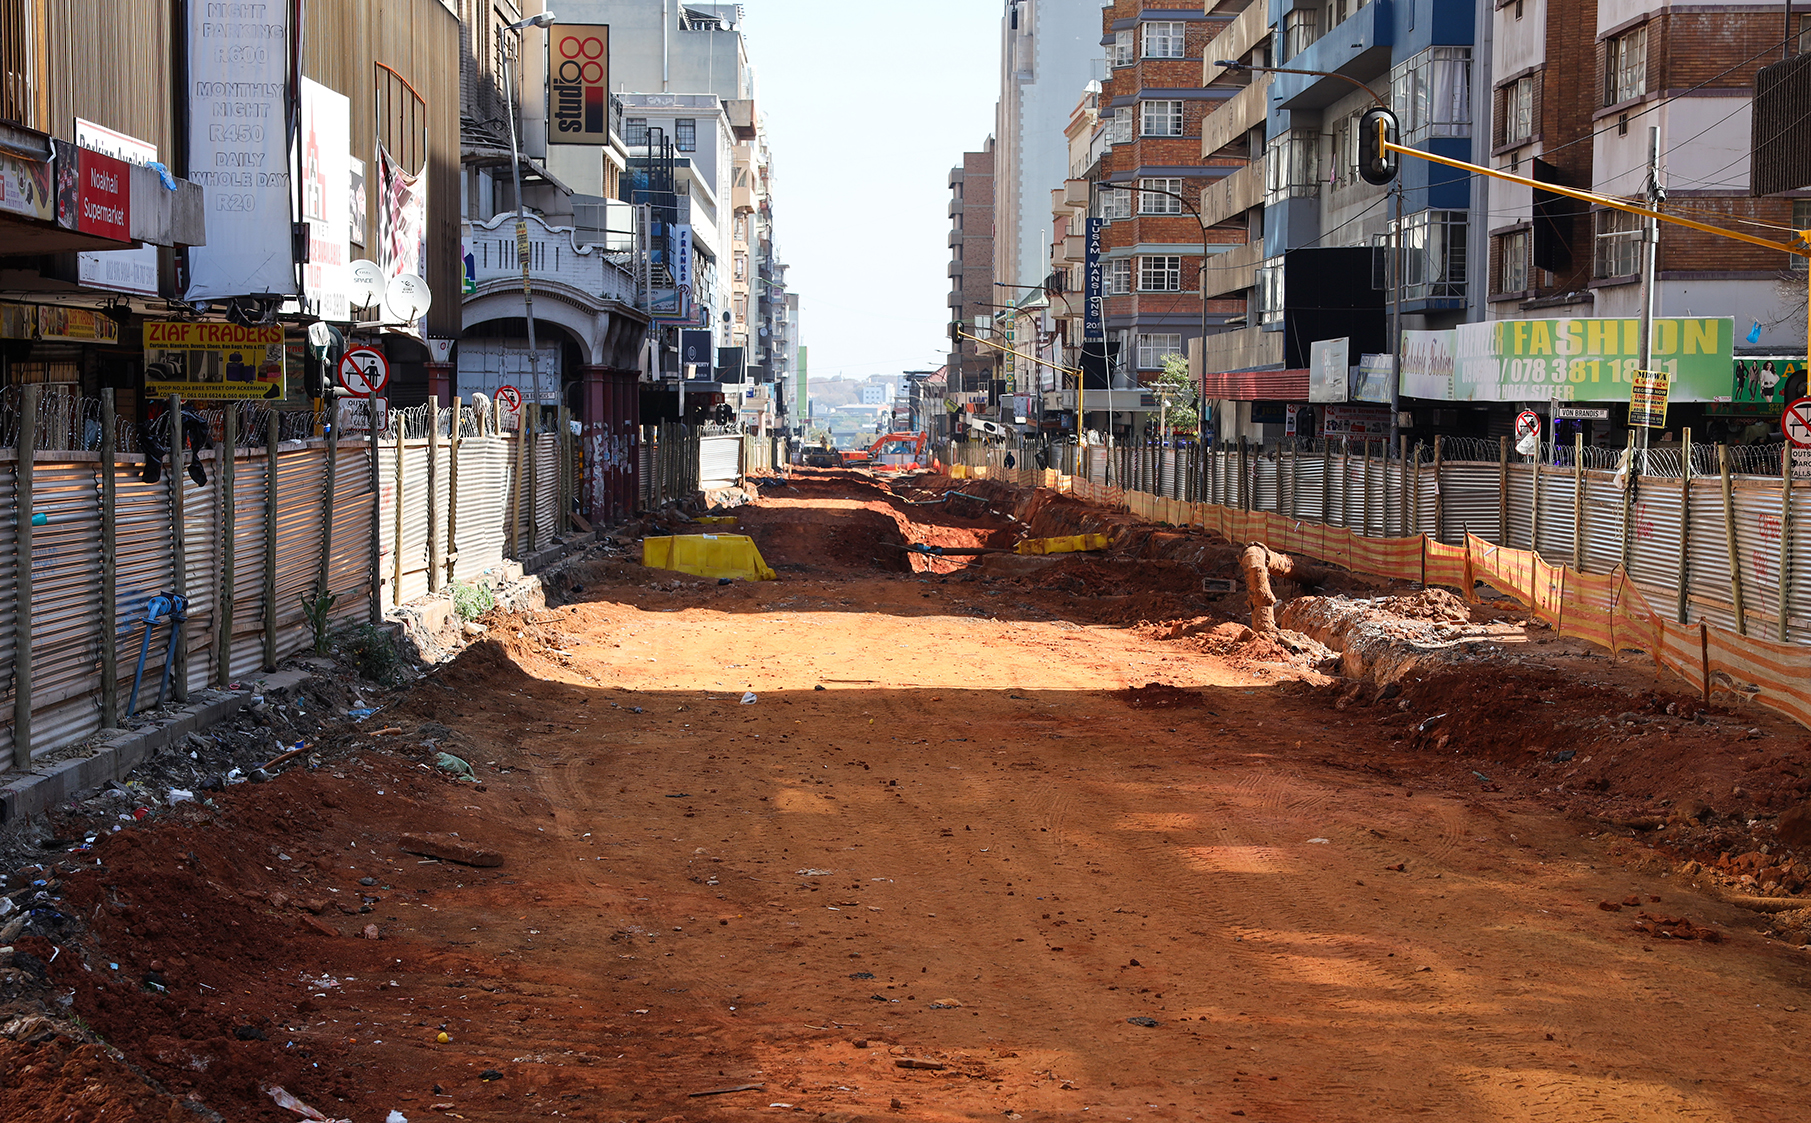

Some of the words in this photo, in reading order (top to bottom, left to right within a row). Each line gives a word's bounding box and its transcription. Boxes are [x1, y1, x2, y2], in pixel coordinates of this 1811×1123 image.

[208, 3, 266, 19] NIGHT
[203, 22, 284, 39] PARKING
[214, 45, 269, 64] R600
[196, 81, 285, 98] MONTHLY
[213, 102, 271, 118] NIGHT
[209, 124, 264, 142] R450
[216, 152, 265, 167] DAILY
[90, 167, 119, 195] Noakhali
[190, 171, 252, 187] WHOLE
[256, 172, 289, 187] DAY
[84, 197, 125, 227] Supermarket
[216, 194, 255, 212] R20
[1090, 220, 1100, 254] LUSAM
[1090, 262, 1100, 317] MANSIONS
[149, 323, 191, 342] ZIAF
[195, 323, 282, 343] TRADERS
[1511, 358, 1546, 383] 078
[1551, 358, 1600, 383] 381
[1531, 384, 1575, 400] STEER
[1575, 409, 1599, 417] BRANDIS
